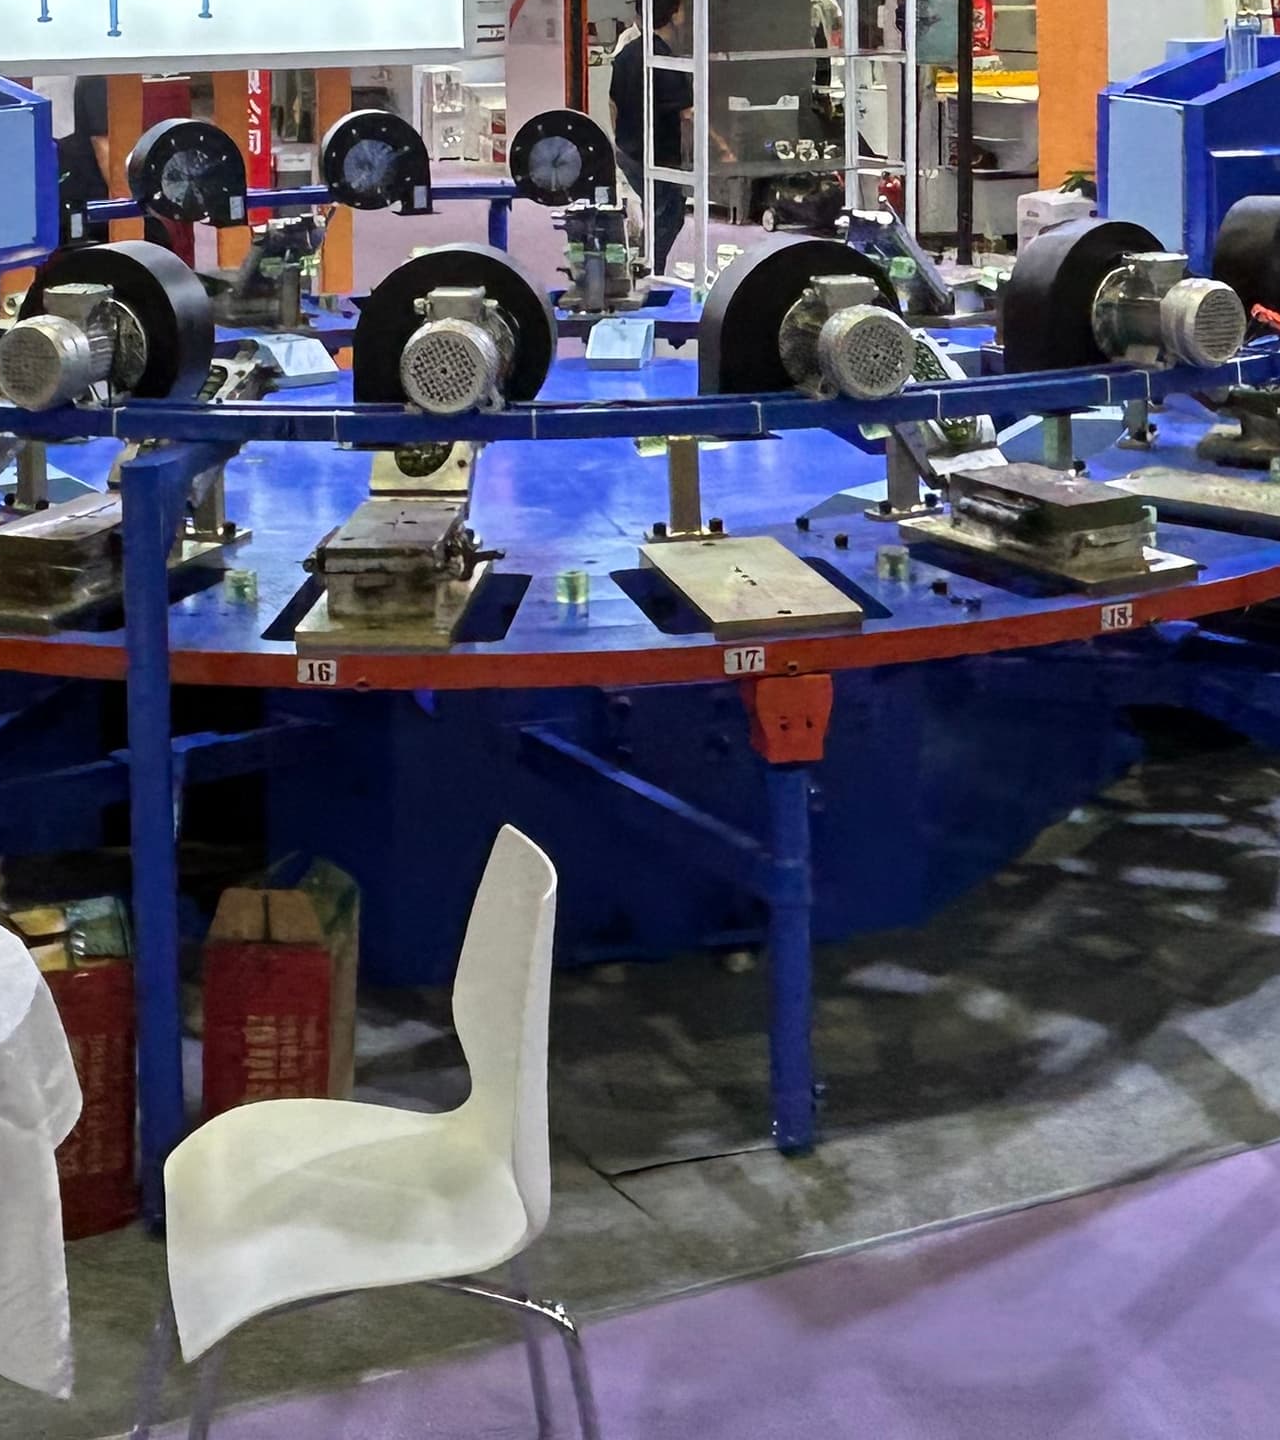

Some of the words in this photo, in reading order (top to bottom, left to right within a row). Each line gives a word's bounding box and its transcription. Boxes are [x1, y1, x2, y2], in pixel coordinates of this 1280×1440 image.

[1109, 606, 1129, 628] 18
[734, 649, 761, 671] 17
[306, 662, 332, 682] 16
